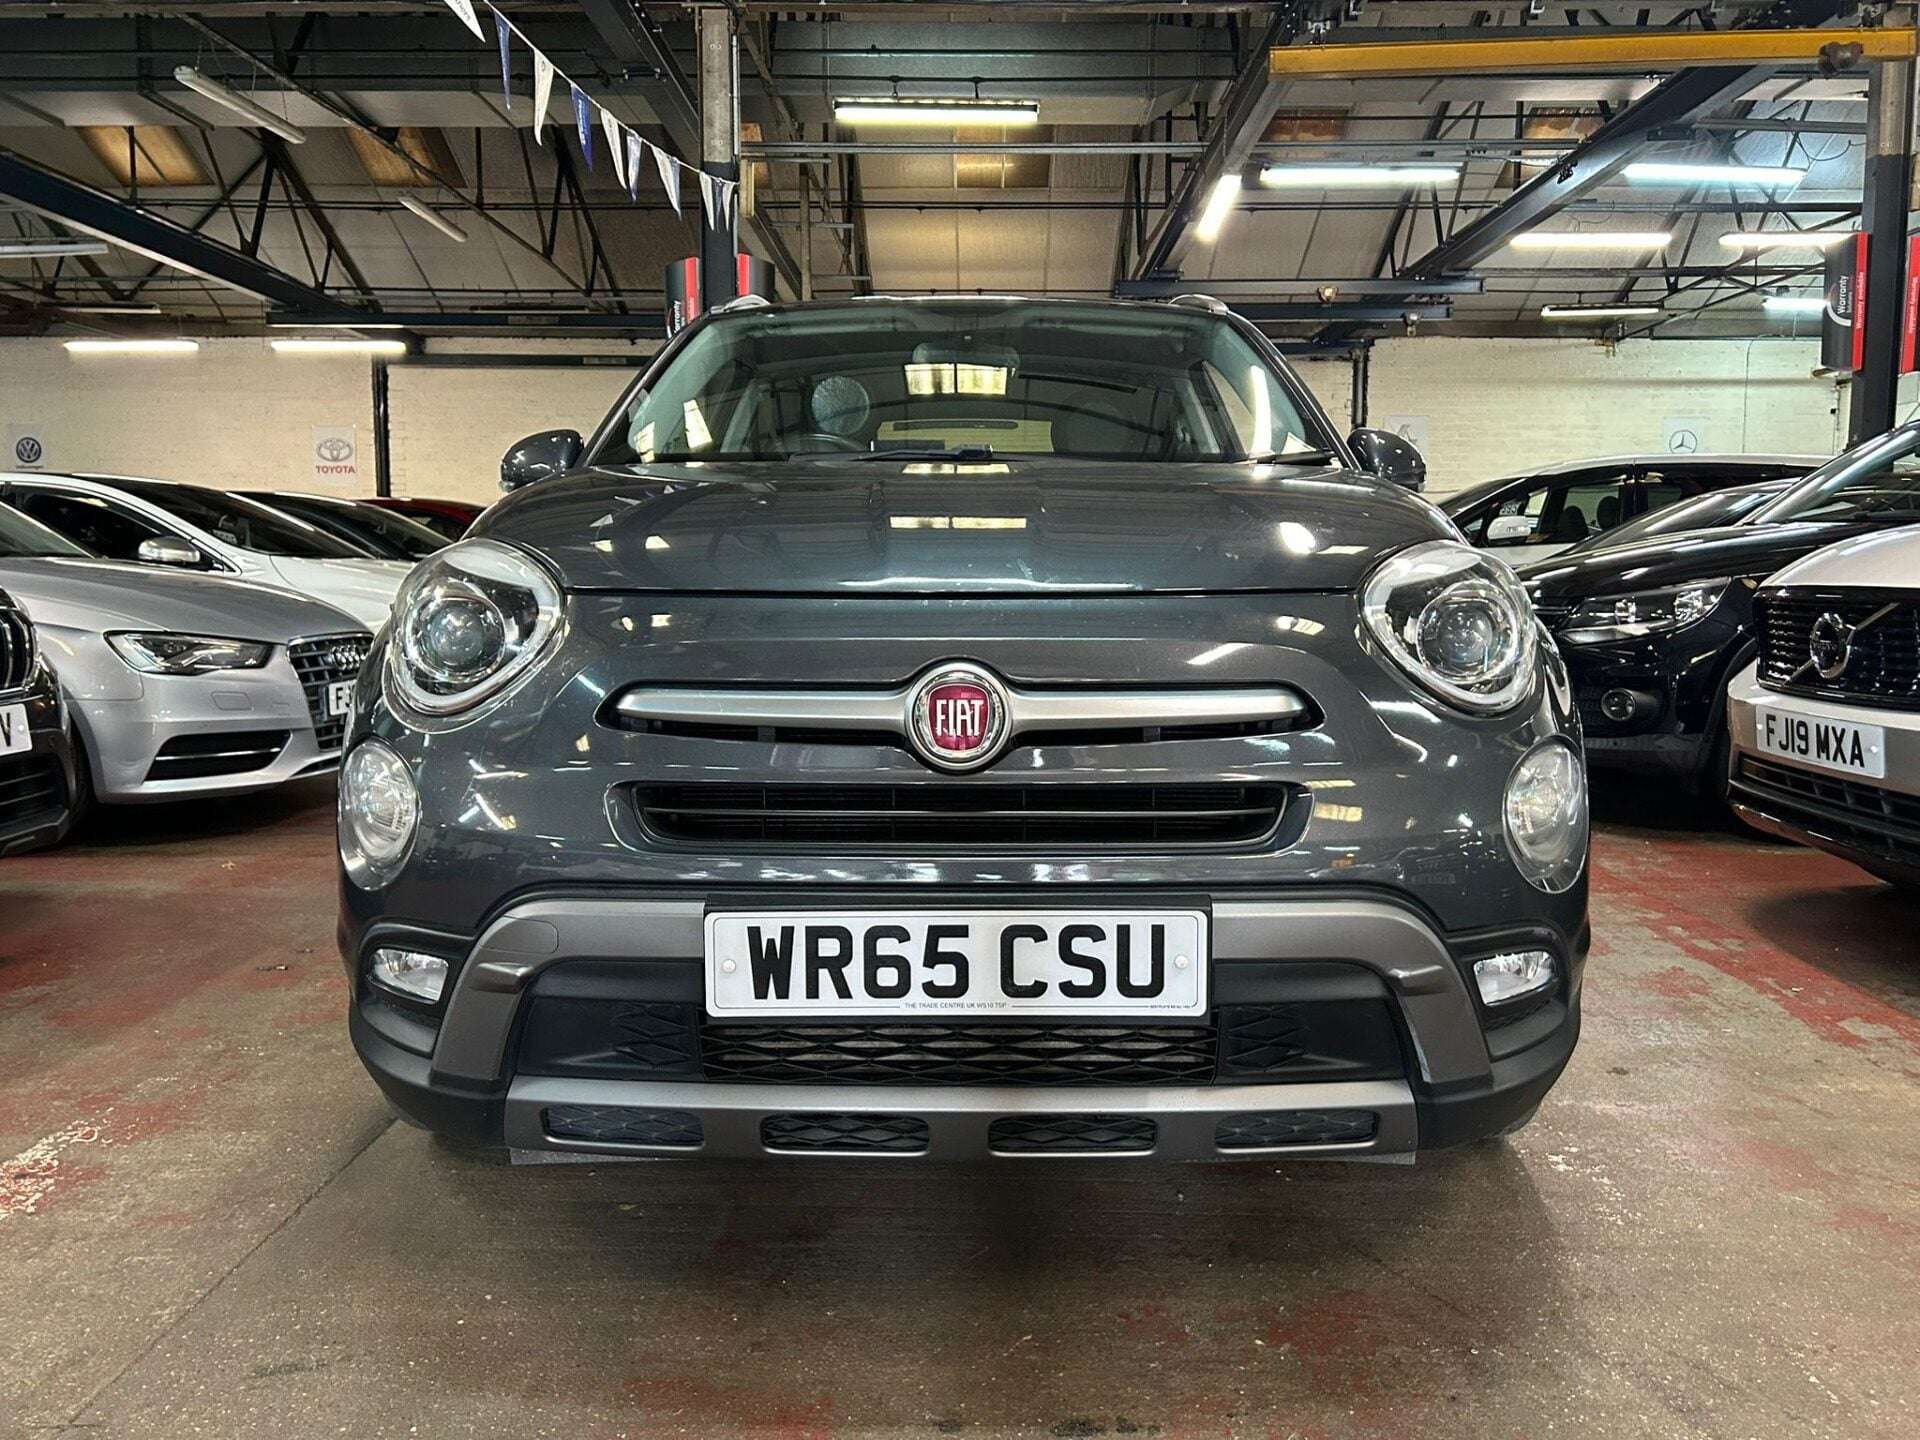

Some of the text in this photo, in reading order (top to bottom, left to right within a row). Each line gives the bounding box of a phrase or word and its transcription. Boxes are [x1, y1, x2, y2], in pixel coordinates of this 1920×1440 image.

[1836, 275, 1849, 315] Warranty
[315, 464, 356, 474] TOYOTA
[935, 699, 984, 737] FIAT
[1765, 713, 1865, 768] FJ19 MXA
[746, 924, 1165, 1000] WR65 CSU
[904, 1001, 916, 1009] THE
[918, 1001, 939, 1009] TRADE
[939, 1001, 964, 1009] CENTRE
[966, 1001, 975, 1009] UK
